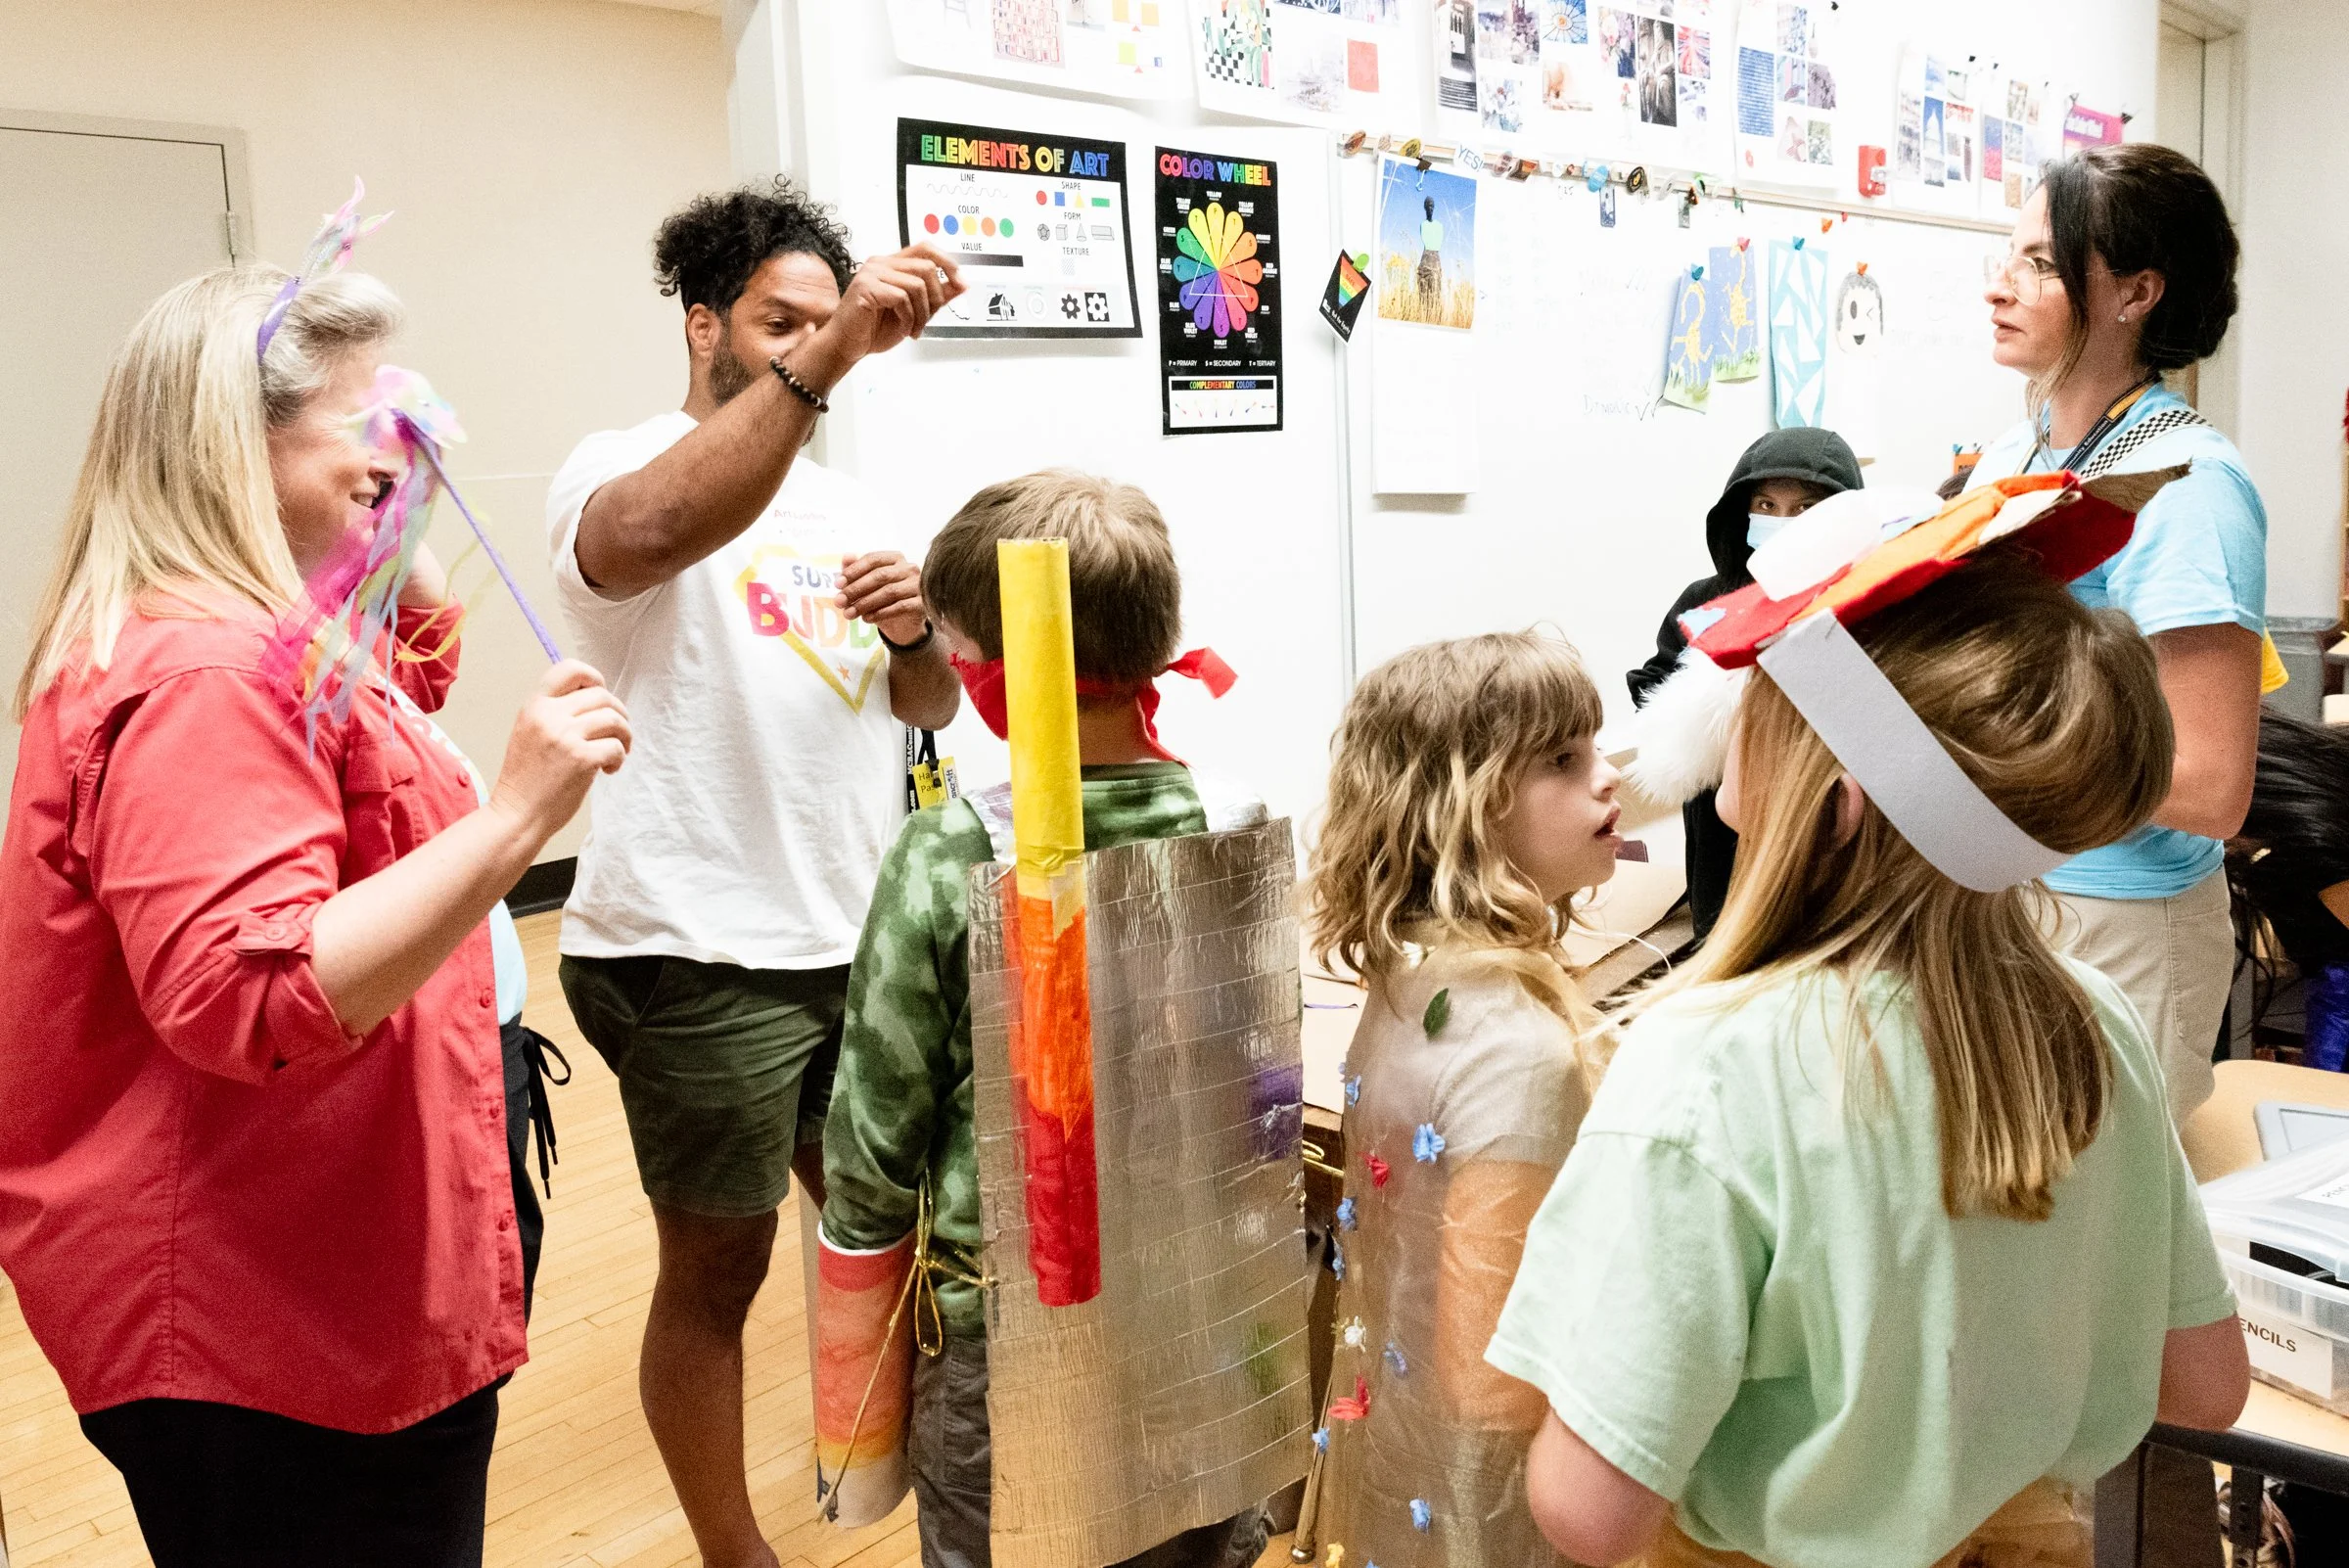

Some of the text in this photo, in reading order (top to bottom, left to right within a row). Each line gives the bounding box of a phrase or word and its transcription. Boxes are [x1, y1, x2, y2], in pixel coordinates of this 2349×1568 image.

[921, 134, 1110, 177] ELEMENTS OF ART
[1457, 143, 1484, 173] YES!
[1159, 153, 1271, 186] COLOR WHEEL
[960, 172, 975, 182] LINE
[1061, 181, 1082, 191] SHAPE
[957, 205, 980, 214] COLOR
[1064, 211, 1082, 221] FORM
[960, 242, 983, 252] VALUE
[1062, 247, 1090, 256] TEXTURE
[1256, 359, 1276, 368] TERTIARY
[1189, 380, 1257, 390] COMPLEMENTARY COLORS
[2083, 420, 2109, 446] Education
[2238, 1316, 2297, 1353] ENCILS
